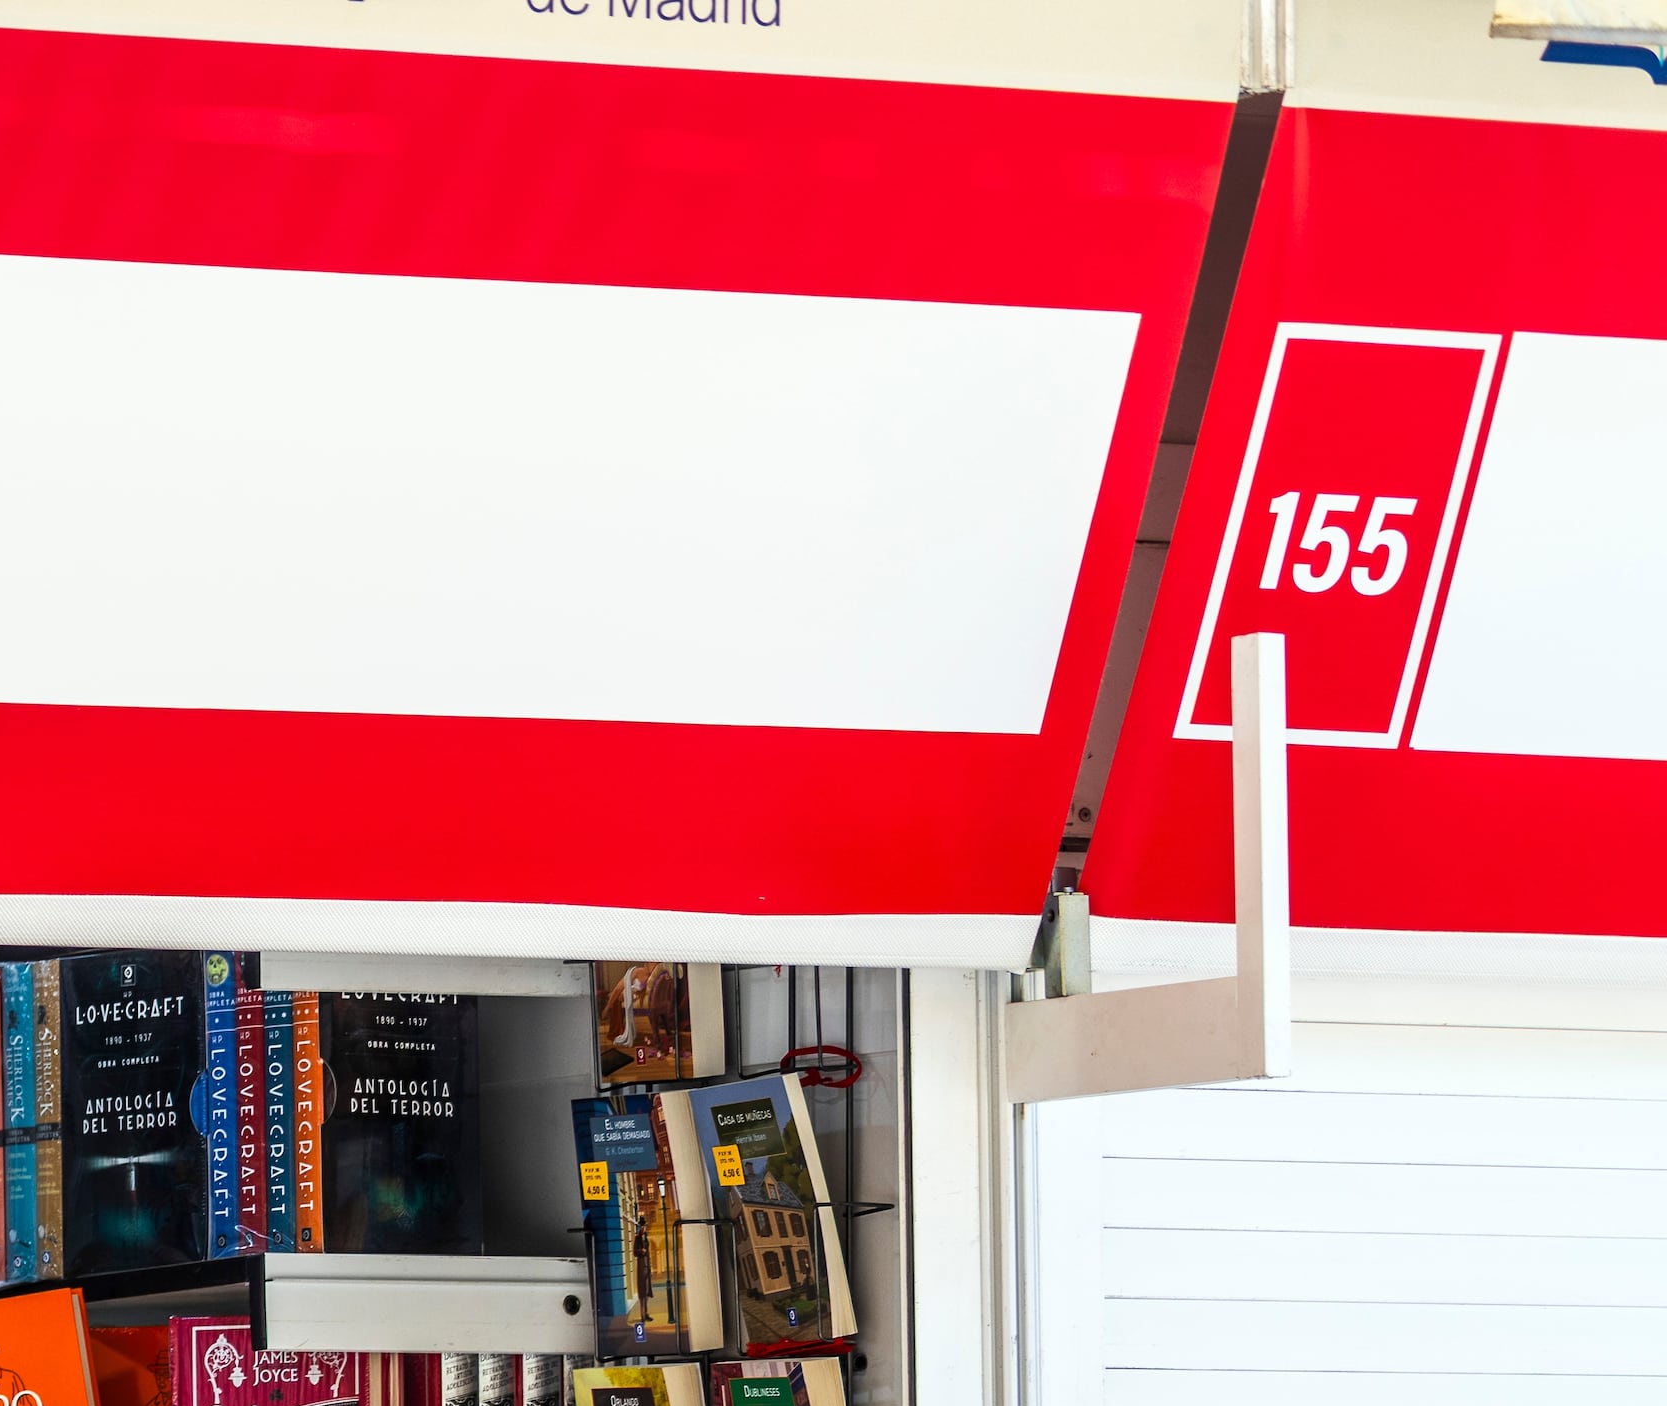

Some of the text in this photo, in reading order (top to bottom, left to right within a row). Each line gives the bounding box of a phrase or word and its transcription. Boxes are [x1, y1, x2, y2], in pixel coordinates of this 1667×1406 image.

[1259, 491, 1418, 596] 155
[368, 1041, 435, 1050] OBRA COMPLETA
[97, 1056, 160, 1069] OBRA COMPLETA
[354, 1078, 450, 1097] ANTOLOGÍA
[86, 1092, 173, 1115] ANTOLOGÍA
[351, 1098, 454, 1117] DEL TERROR
[82, 1113, 177, 1135] DEL TERROR
[604, 1119, 635, 1131] EL HOMBRE
[253, 1351, 298, 1365] JAMES
[253, 1366, 298, 1385] JOYCE
[744, 1386, 779, 1398] DUBLINESES
